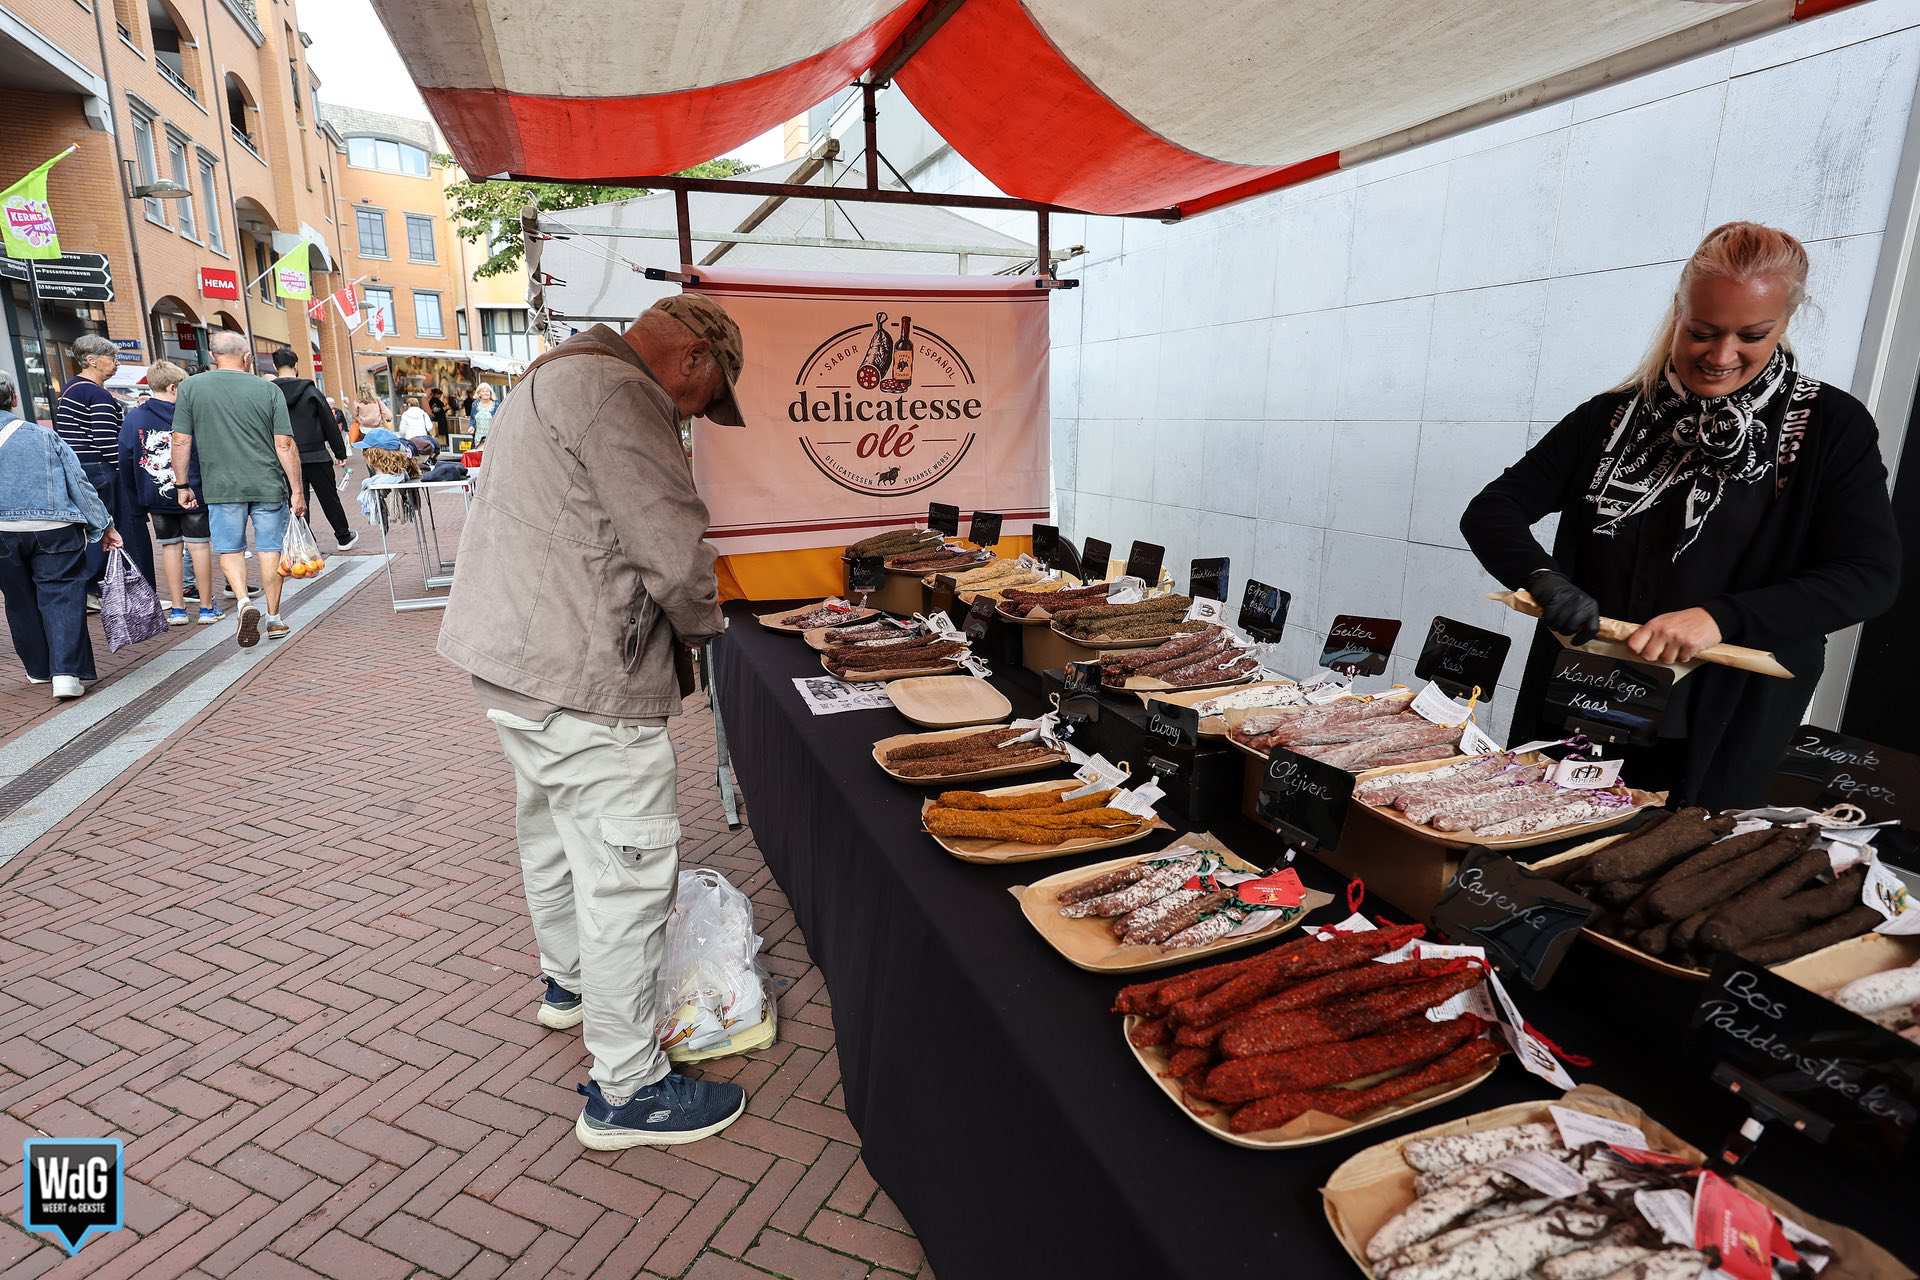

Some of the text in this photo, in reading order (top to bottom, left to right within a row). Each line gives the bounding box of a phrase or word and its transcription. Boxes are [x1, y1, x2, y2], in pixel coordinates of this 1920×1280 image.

[204, 278, 235, 290] HEMA
[824, 344, 957, 380] SABOR ESPAÑOL
[788, 390, 983, 423] delicatesse
[856, 423, 920, 459] olé
[1779, 408, 1812, 465] GUESS
[825, 450, 953, 486] DELICATESSEN SPAANSE WORST
[1343, 641, 1370, 656] Kaas
[1442, 655, 1465, 675] Kaas
[1568, 693, 1610, 714] Kaas
[1149, 712, 1182, 747] Curry
[1723, 969, 1787, 1020] Bos
[1700, 1000, 1904, 1124] Paddenstoelen
